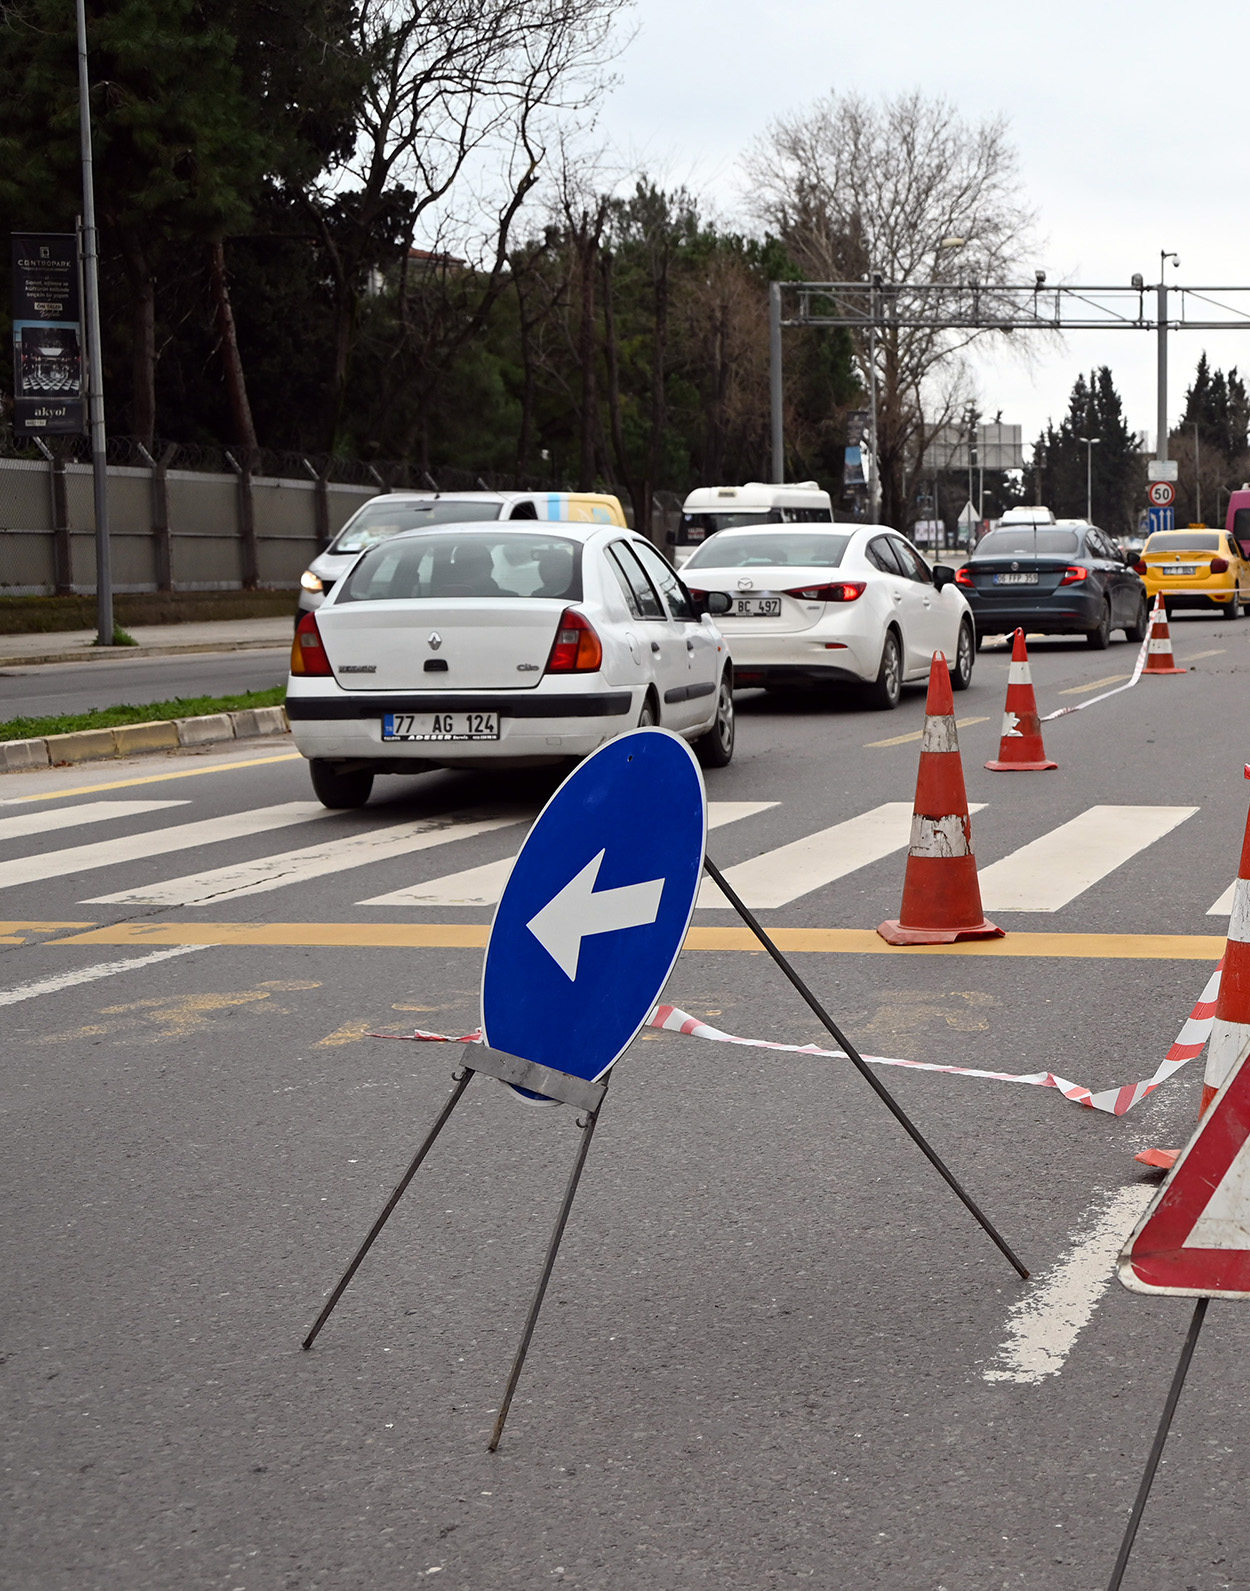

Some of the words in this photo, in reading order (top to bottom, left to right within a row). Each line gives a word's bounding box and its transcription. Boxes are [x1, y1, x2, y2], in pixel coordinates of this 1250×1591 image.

[34, 406, 66, 419] akyol
[1154, 488, 1170, 500] 50
[738, 601, 751, 612] BC
[758, 600, 778, 612] 497
[394, 715, 415, 733] 77
[432, 714, 453, 733] AG
[466, 714, 494, 733] 124
